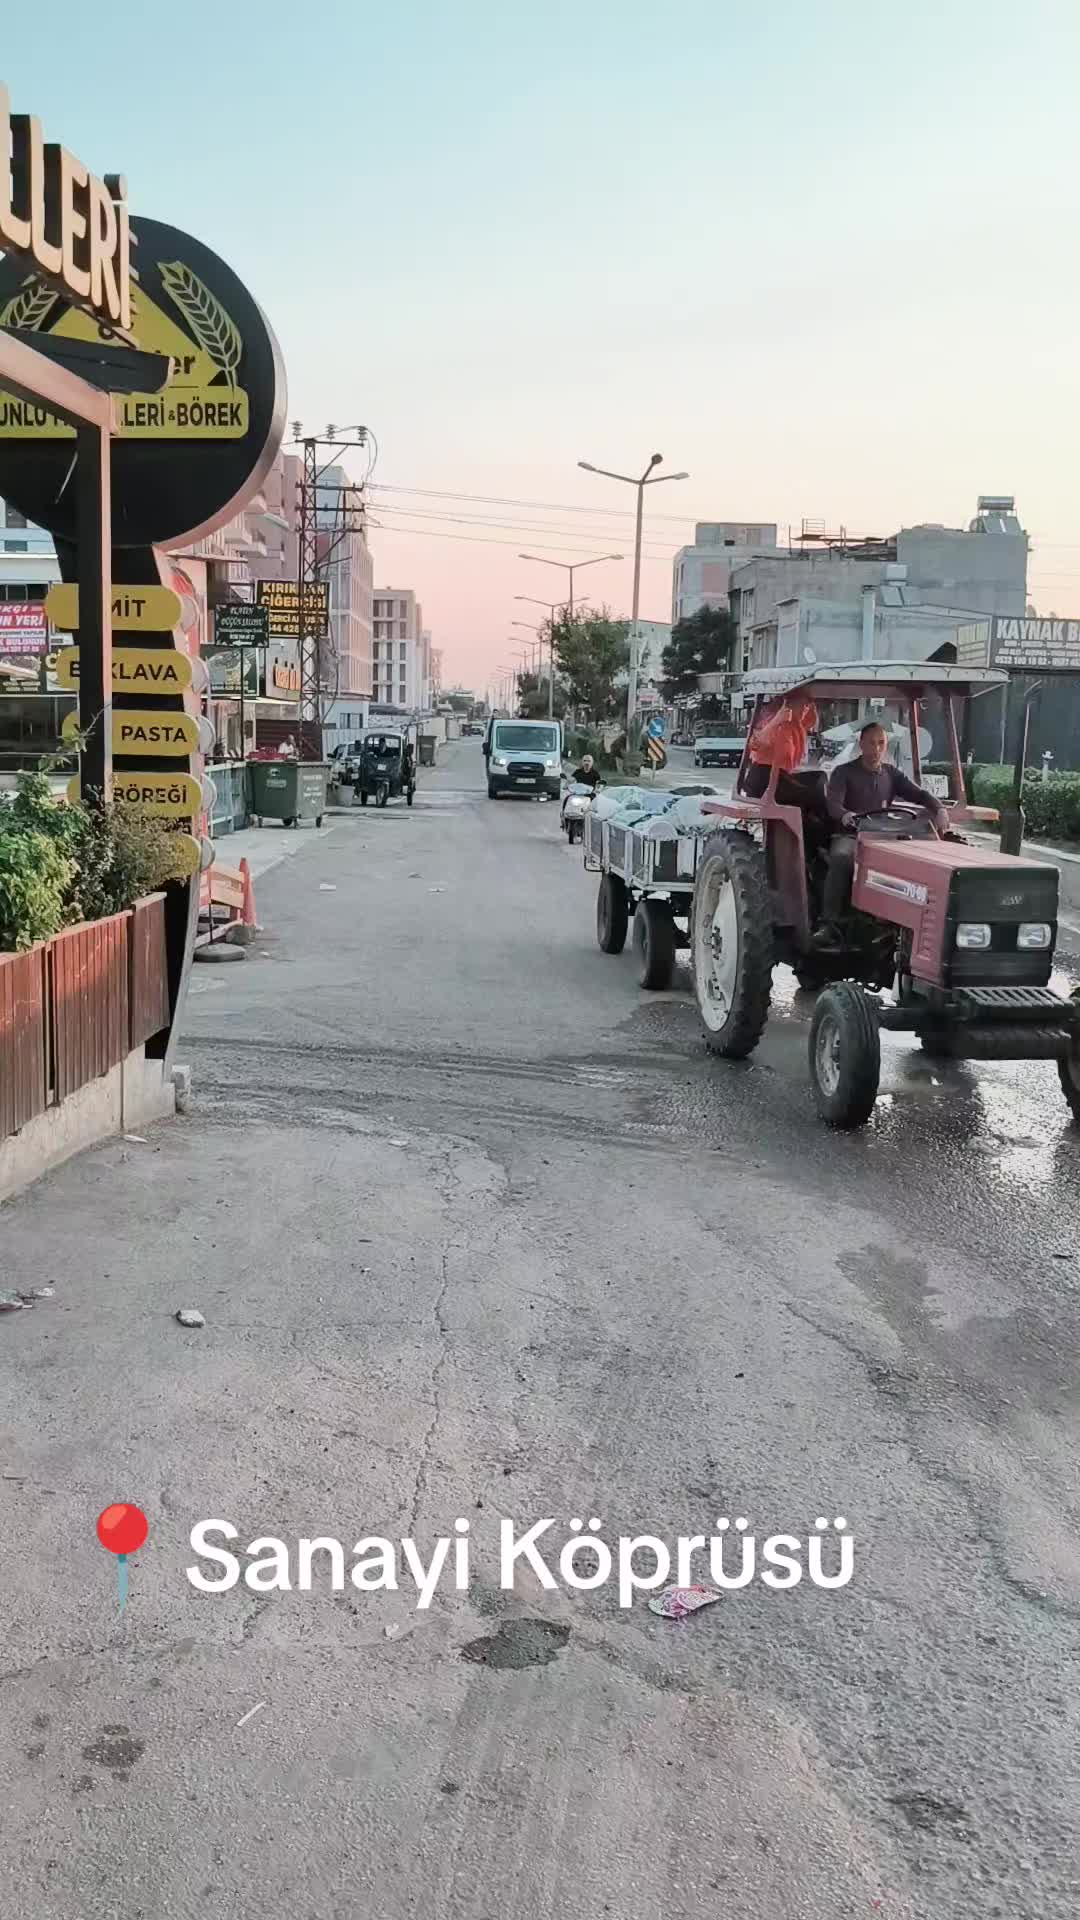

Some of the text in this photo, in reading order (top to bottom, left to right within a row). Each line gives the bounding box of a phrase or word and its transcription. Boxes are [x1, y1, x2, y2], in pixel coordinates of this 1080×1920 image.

[177, 397, 242, 427] BÖREK
[997, 619, 1064, 641] KAYNAK
[121, 725, 188, 743] PASTA
